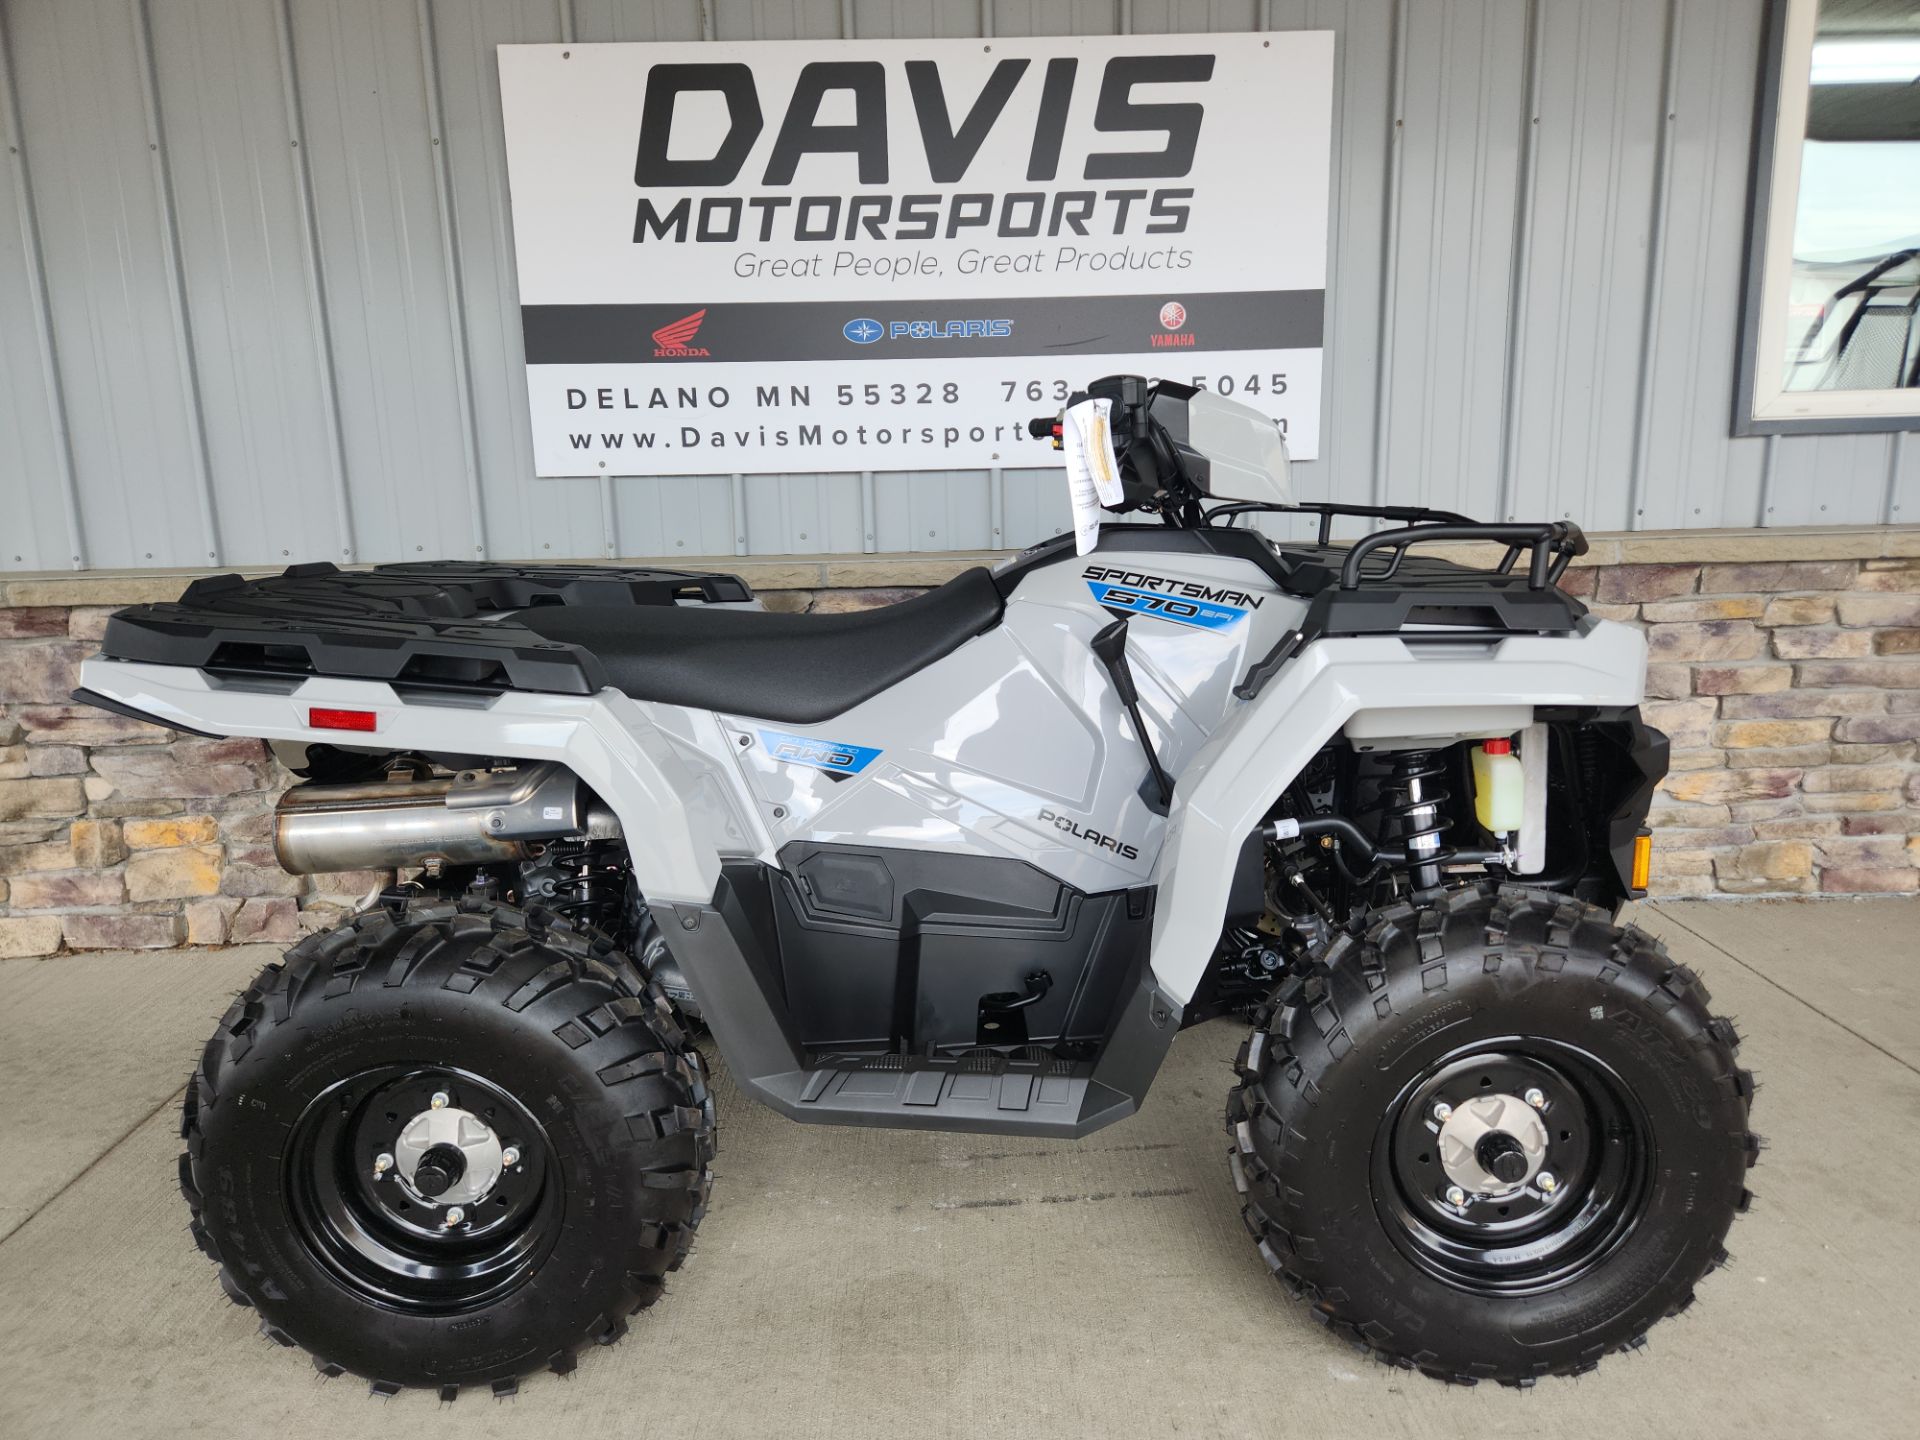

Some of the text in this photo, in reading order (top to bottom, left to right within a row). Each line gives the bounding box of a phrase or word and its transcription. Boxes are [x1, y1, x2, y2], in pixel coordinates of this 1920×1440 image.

[633, 53, 1216, 187] DAVIS
[633, 188, 1194, 243] MOTORSPORTS
[733, 245, 1194, 282] Great People, Great Products
[889, 319, 1012, 339] POLARIS
[1150, 333, 1195, 347] YAMAHA
[653, 347, 711, 357] HONDA
[566, 386, 730, 410] DELANO
[756, 385, 811, 407] MN
[837, 382, 960, 406] 55328
[569, 417, 1288, 449] www.DavisMotorsport
[1081, 565, 1265, 610] SPORTSMAN
[1102, 587, 1200, 618] 570
[774, 742, 855, 767] AWD
[1037, 807, 1139, 861] POLARIS
